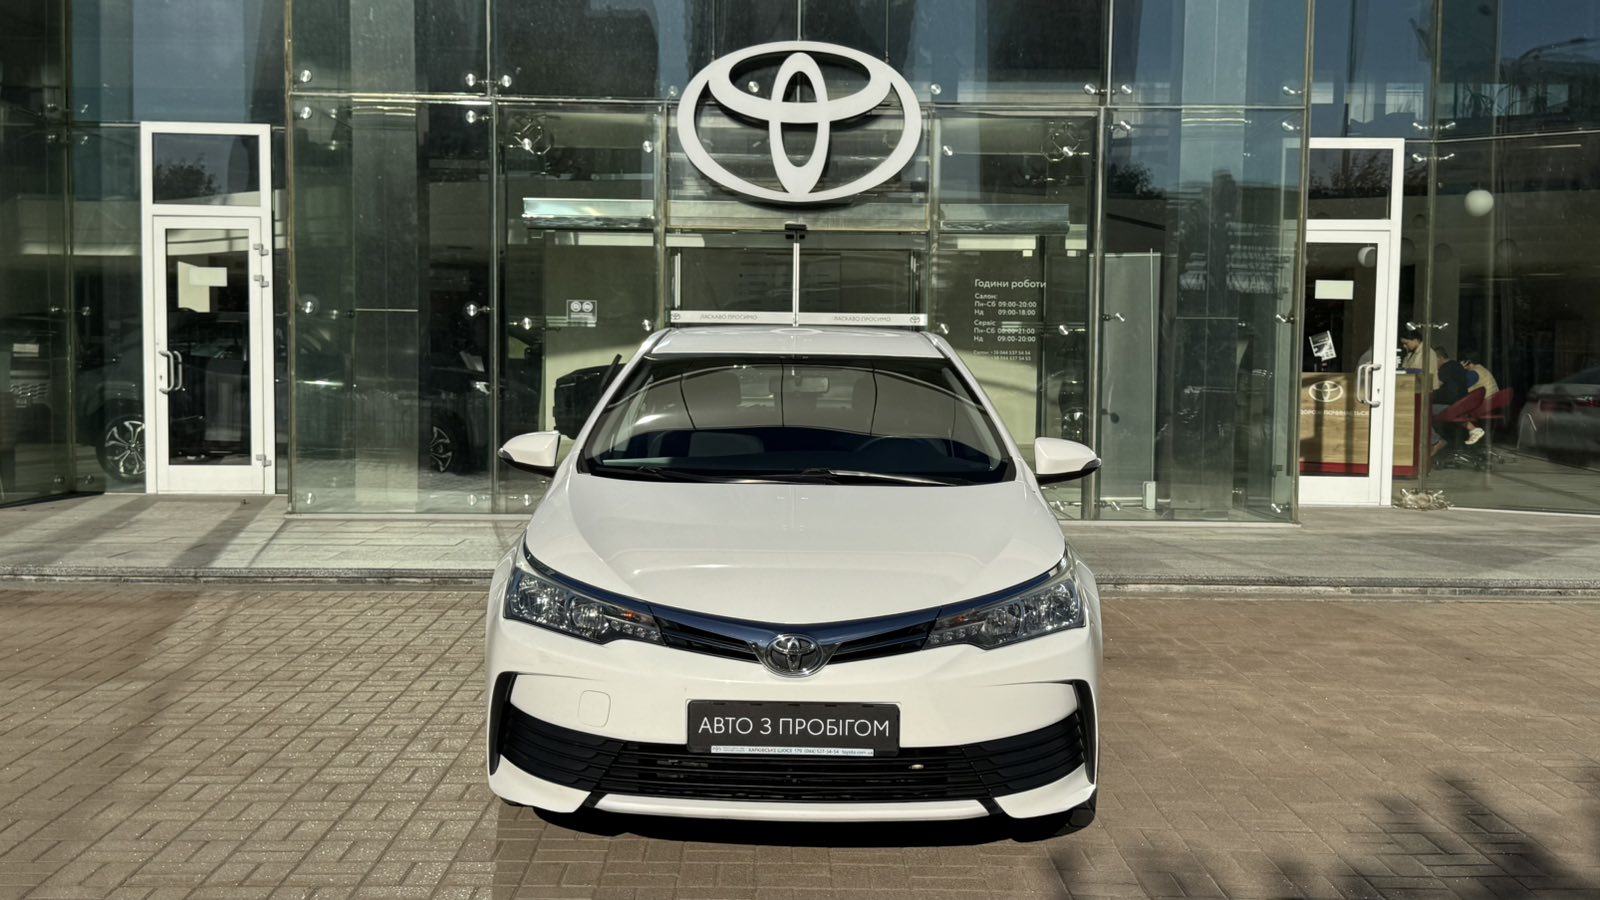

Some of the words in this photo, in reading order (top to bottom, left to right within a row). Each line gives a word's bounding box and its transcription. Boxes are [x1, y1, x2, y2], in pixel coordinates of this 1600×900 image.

[974, 279, 1009, 289] Години
[1011, 279, 1047, 290] роботи
[974, 309, 984, 317] Нд
[698, 716, 753, 735] АВТО
[759, 717, 772, 735] З
[778, 717, 890, 737] ПРОБІГОМ
